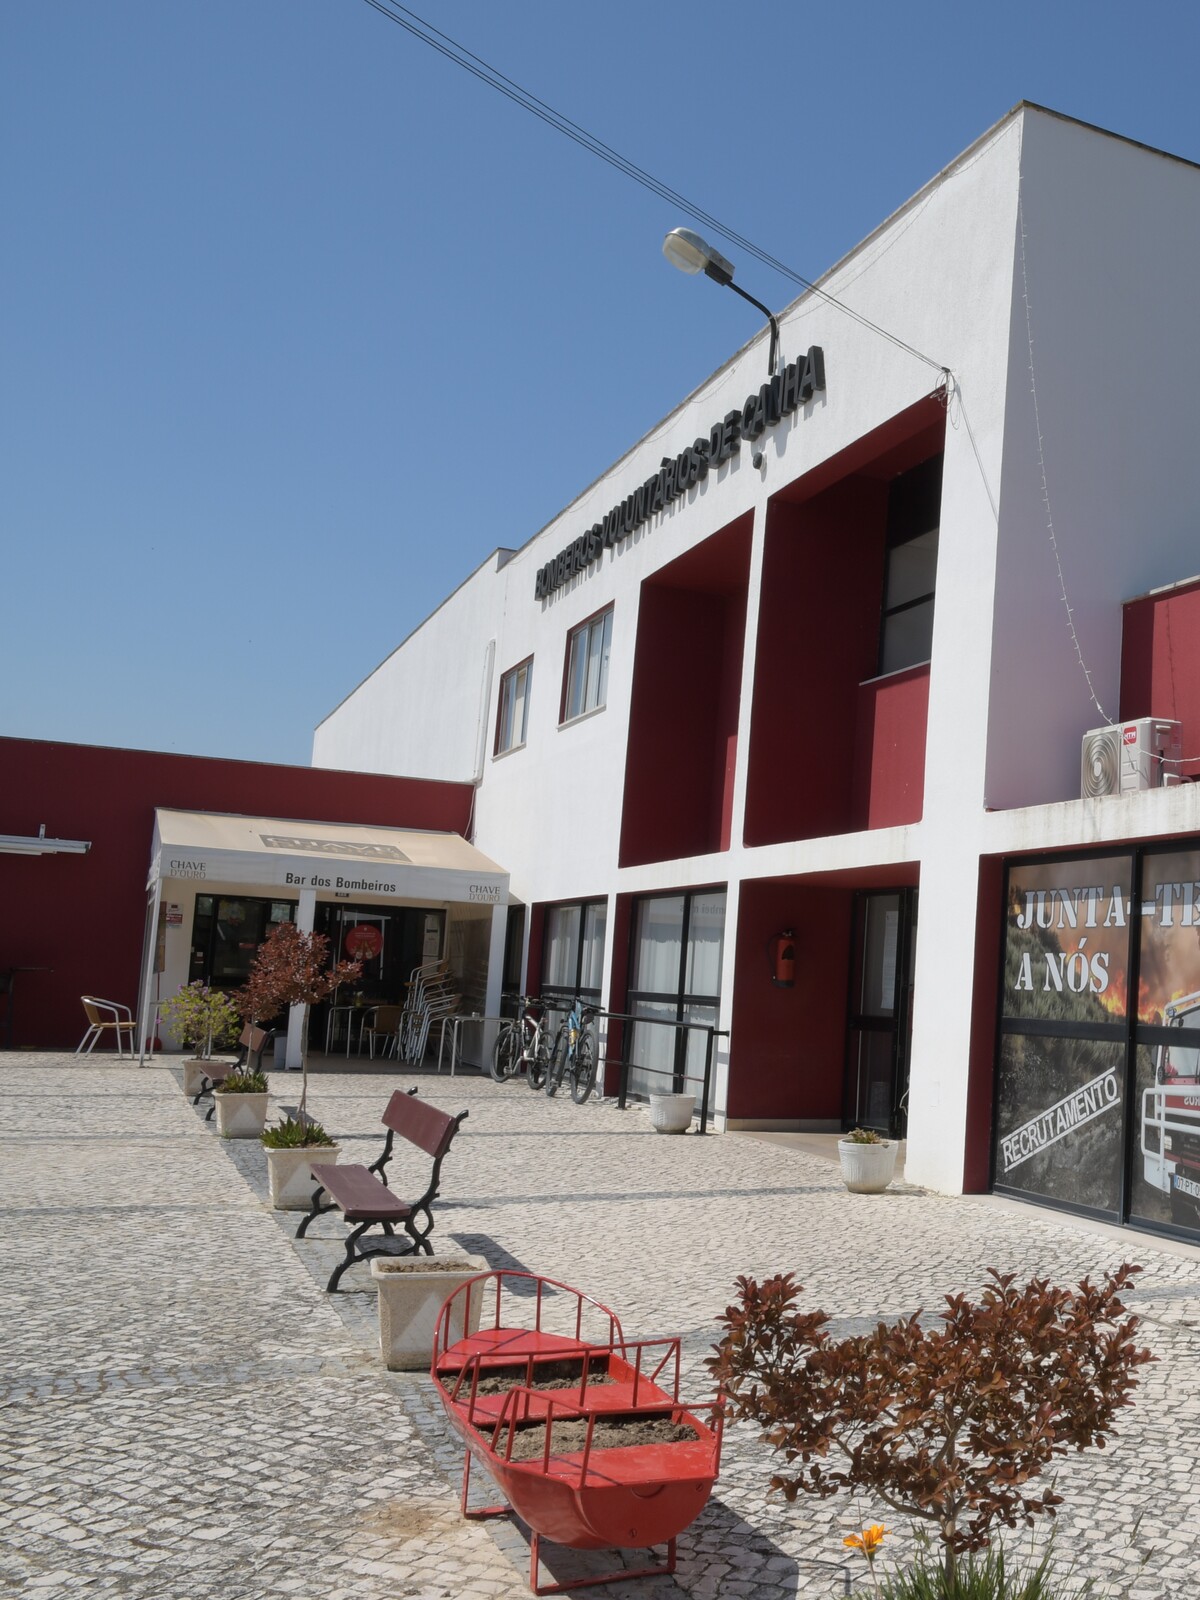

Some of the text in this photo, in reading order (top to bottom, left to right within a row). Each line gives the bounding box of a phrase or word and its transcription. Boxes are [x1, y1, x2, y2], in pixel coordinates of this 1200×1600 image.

[534, 345, 826, 601] BOMBEIROS VOLUNTÁRIOS DE CANHA
[170, 860, 206, 871] CHAVE
[170, 869, 206, 879] D'OURO
[285, 872, 396, 893] Bar dos Bombeiros
[469, 885, 500, 894] CHAVE
[1014, 937, 1110, 993] A NÓS
[1002, 1074, 1118, 1167] RECRUTAMENTO
